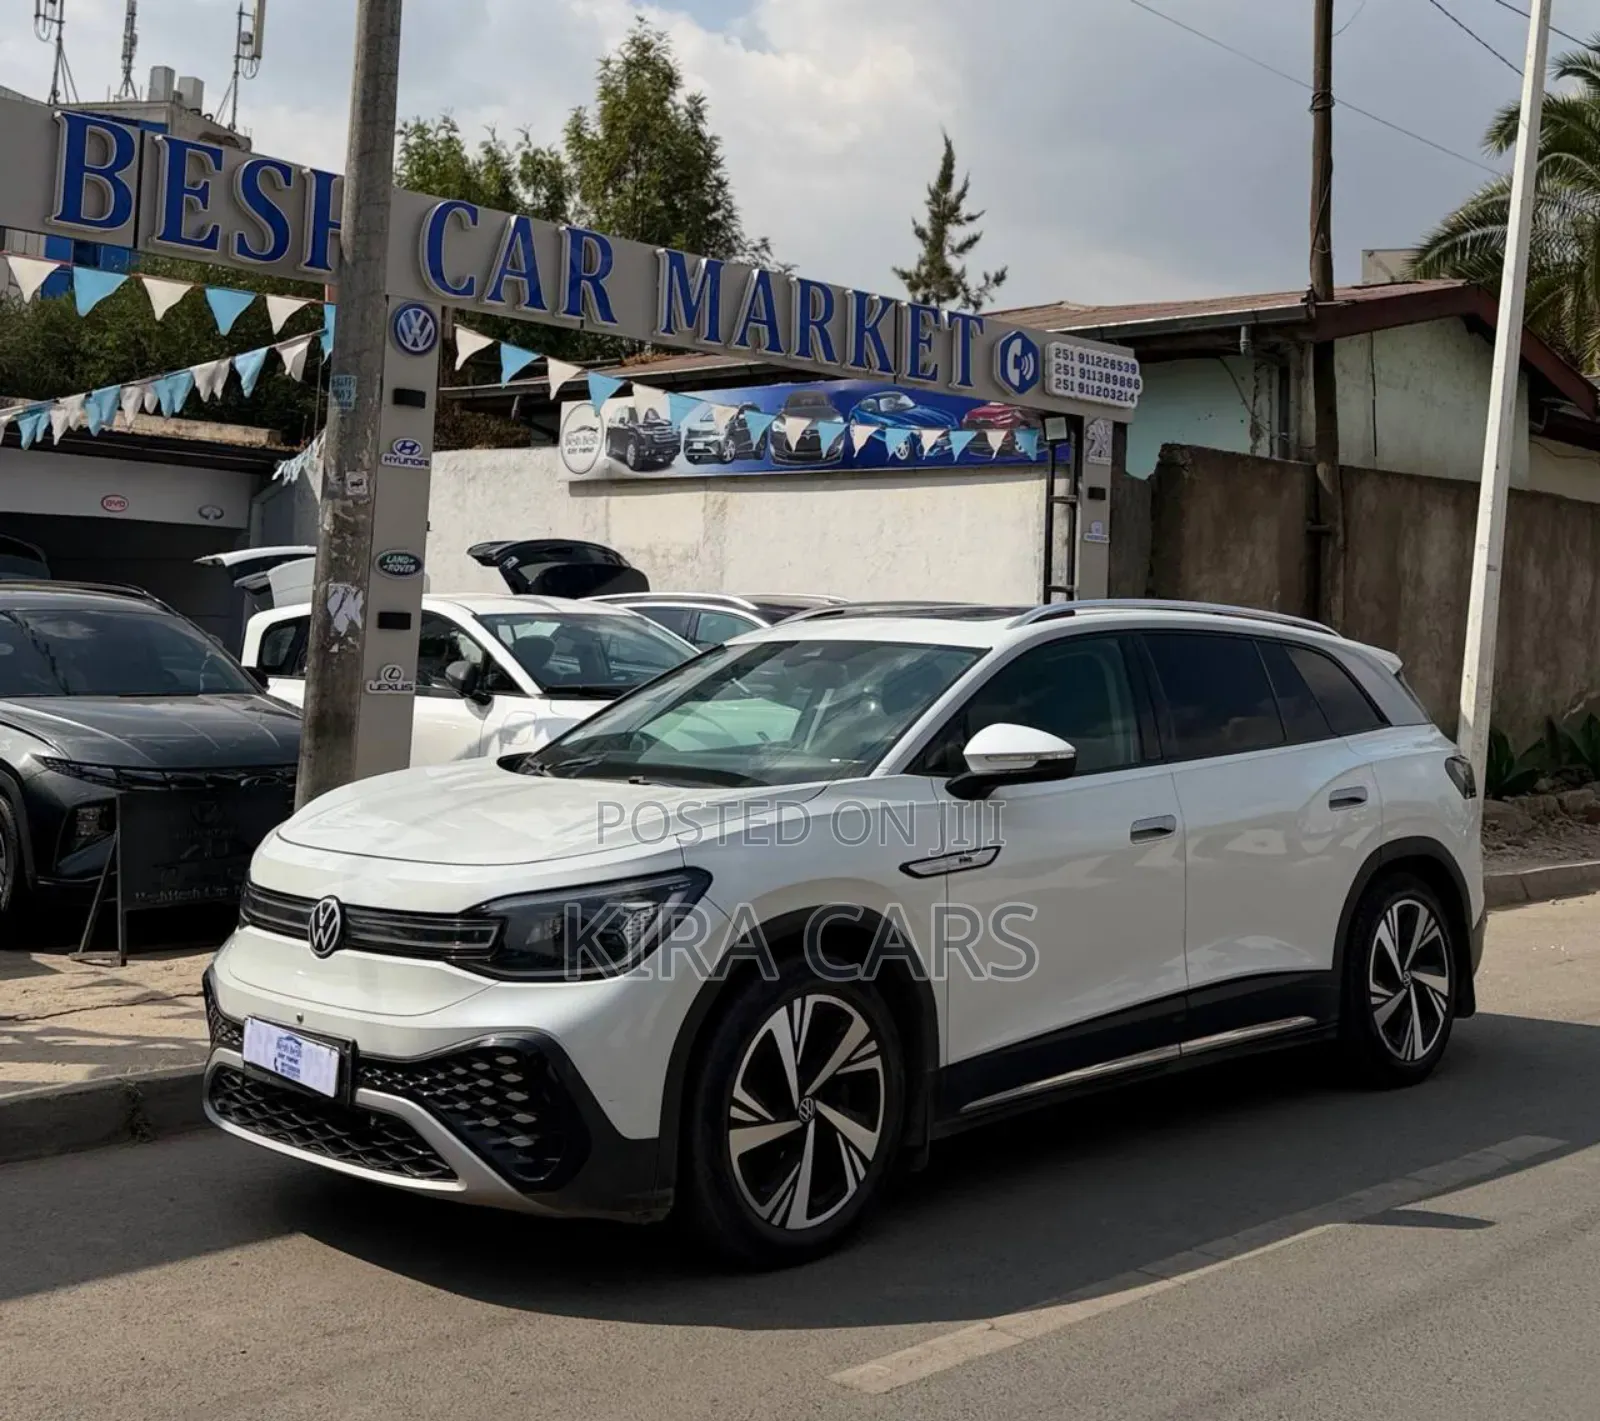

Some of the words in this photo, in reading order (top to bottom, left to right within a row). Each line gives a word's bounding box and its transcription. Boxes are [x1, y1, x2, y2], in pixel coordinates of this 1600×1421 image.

[419, 199, 619, 328] CAR
[654, 248, 985, 389] MARKET
[1055, 348, 1074, 361] 251
[1078, 352, 1137, 374] 911226539
[1055, 363, 1075, 377] 251
[1055, 378, 1074, 392] 251
[1078, 382, 1135, 404] 911203214
[387, 555, 409, 565] LAND
[388, 564, 416, 573] ROVER
[369, 682, 414, 691] LEXUS
